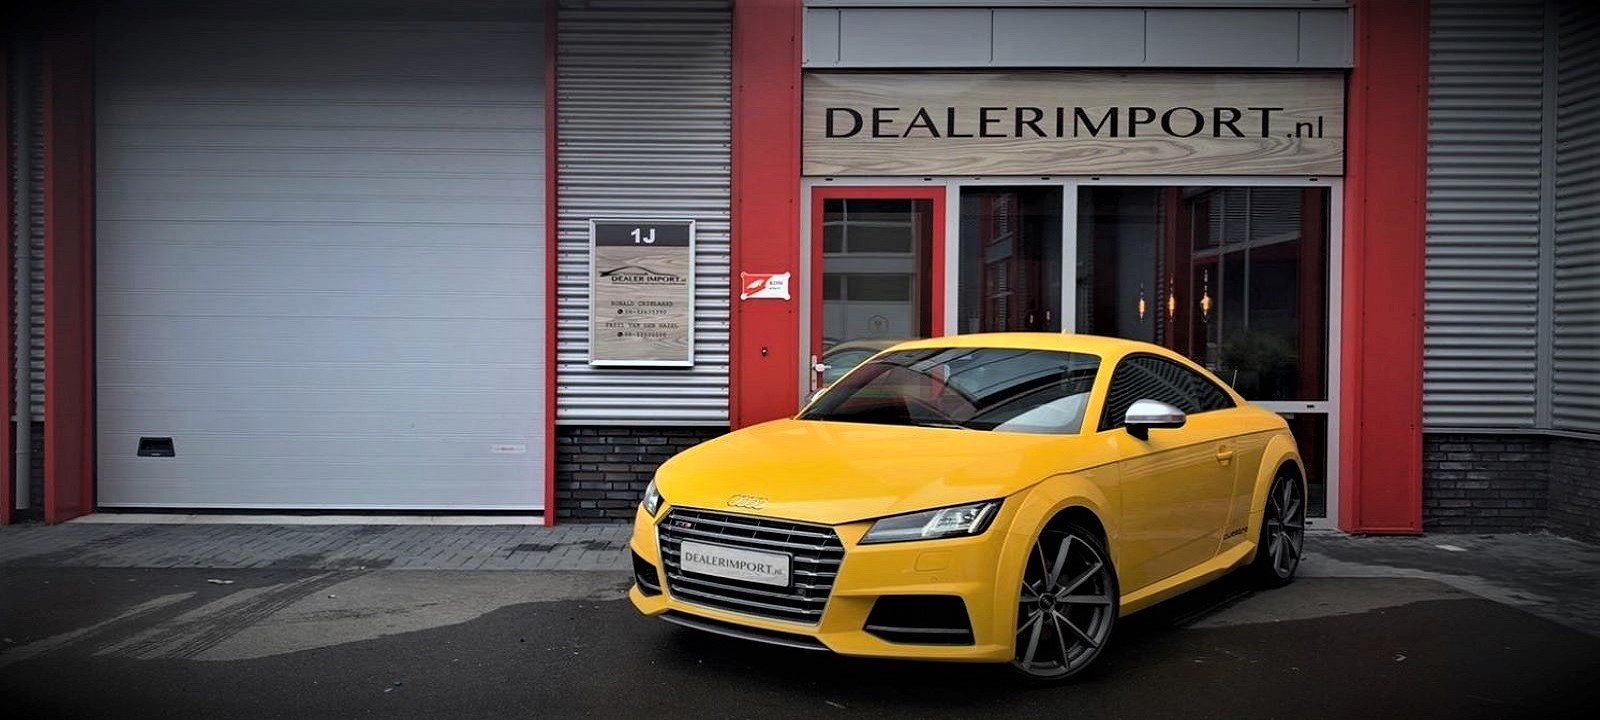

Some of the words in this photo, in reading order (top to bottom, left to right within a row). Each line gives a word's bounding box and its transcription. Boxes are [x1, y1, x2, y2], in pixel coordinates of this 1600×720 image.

[825, 106, 1324, 139] DEALERIMPORT.nl
[630, 227, 656, 244] 1J
[611, 275, 645, 283] DEALER
[684, 551, 783, 576] DEALERIMPORT.nl
